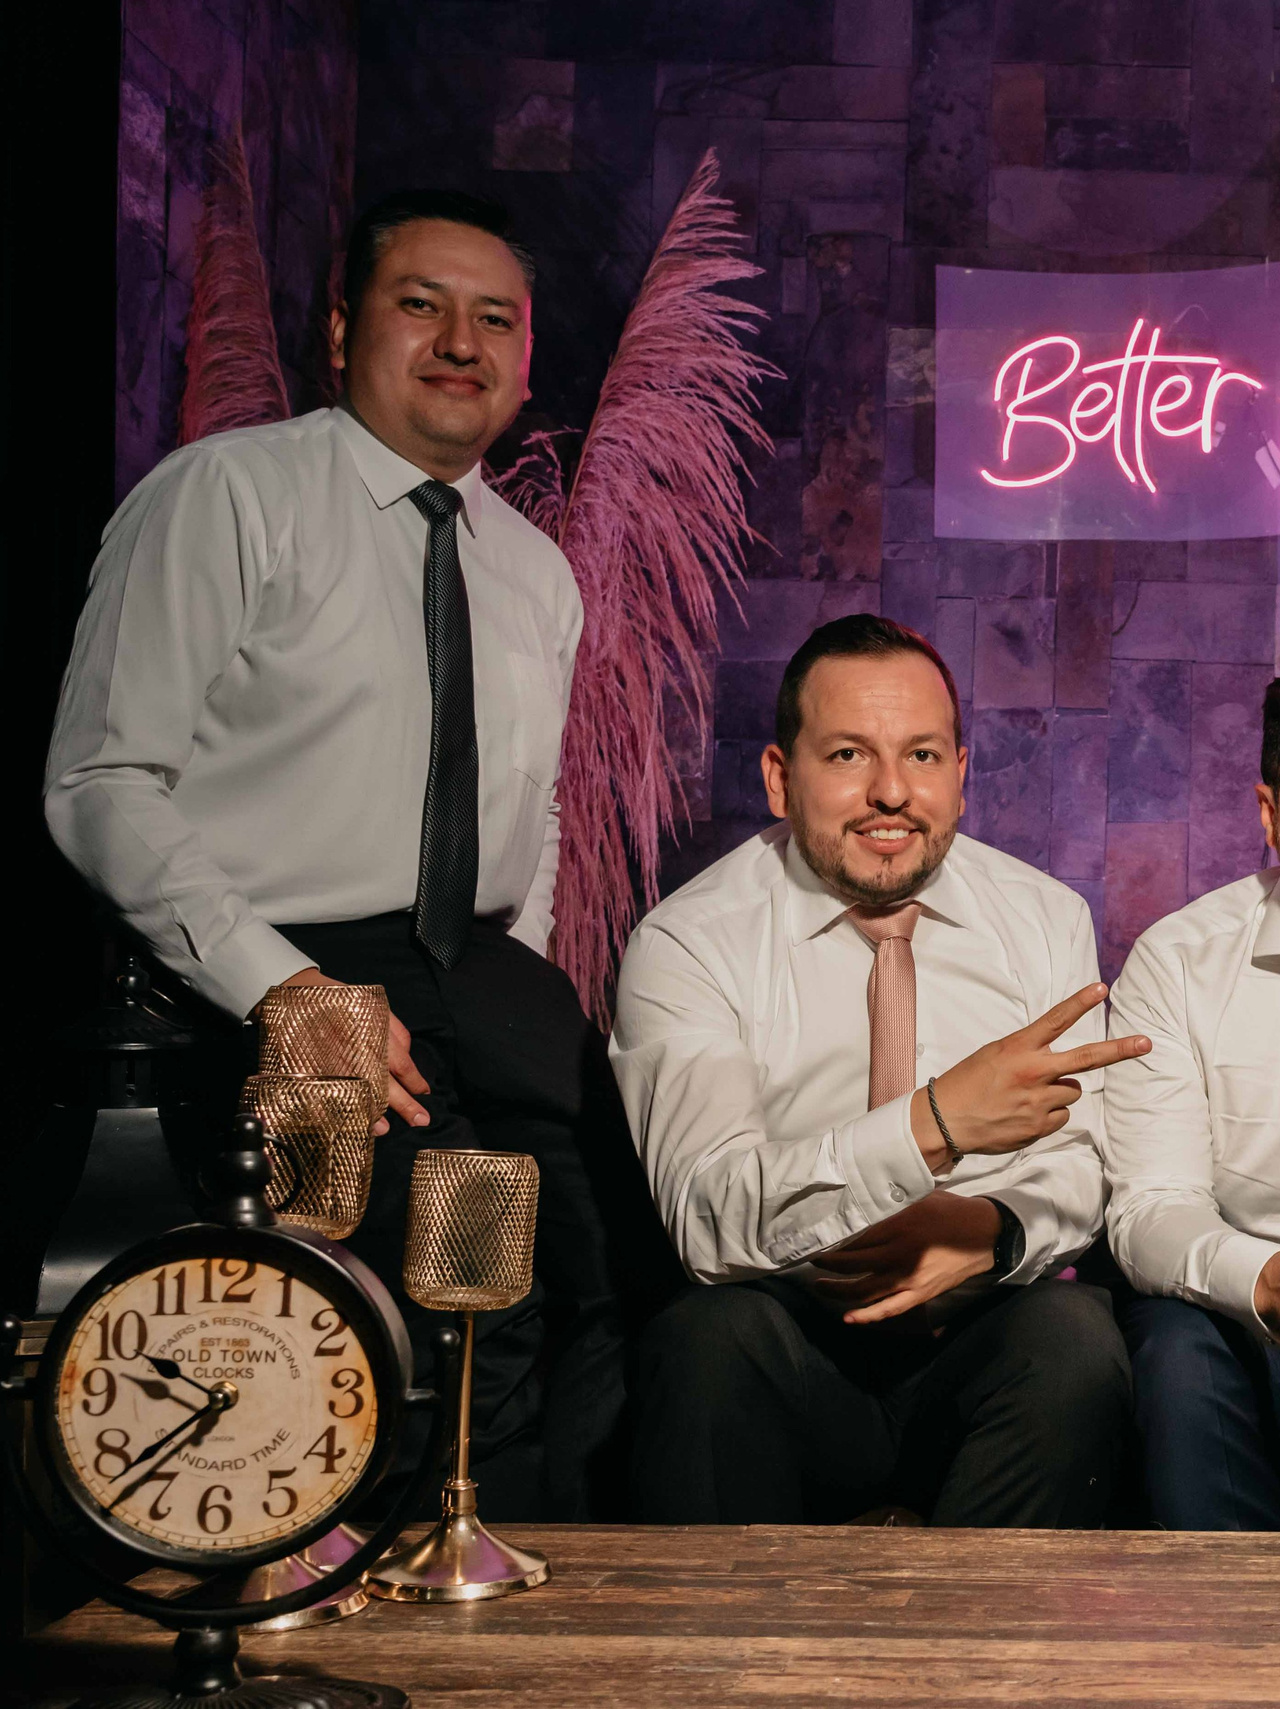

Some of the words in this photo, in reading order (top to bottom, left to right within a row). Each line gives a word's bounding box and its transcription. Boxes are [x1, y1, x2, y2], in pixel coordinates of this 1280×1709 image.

[980, 317, 1263, 494] Better
[150, 1267, 191, 1316] 11
[197, 1258, 258, 1303] 12
[275, 1271, 296, 1318] 1
[94, 1309, 148, 1361] 10
[172, 1348, 212, 1363] OLD
[220, 1349, 277, 1363] TOWN
[199, 1319, 209, 1329] &
[212, 1316, 301, 1380] RESTORATIONS
[200, 1337, 221, 1347] EST
[311, 1308, 349, 1357] 2
[82, 1367, 117, 1416] 9
[193, 1367, 255, 1379] CLOCKS
[328, 1368, 365, 1419] 3
[94, 1428, 133, 1479] 8
[250, 1428, 291, 1463] TIME
[303, 1425, 347, 1475] 4
[146, 1471, 181, 1522] 7
[196, 1485, 233, 1535] 6
[262, 1466, 299, 1518] 5
